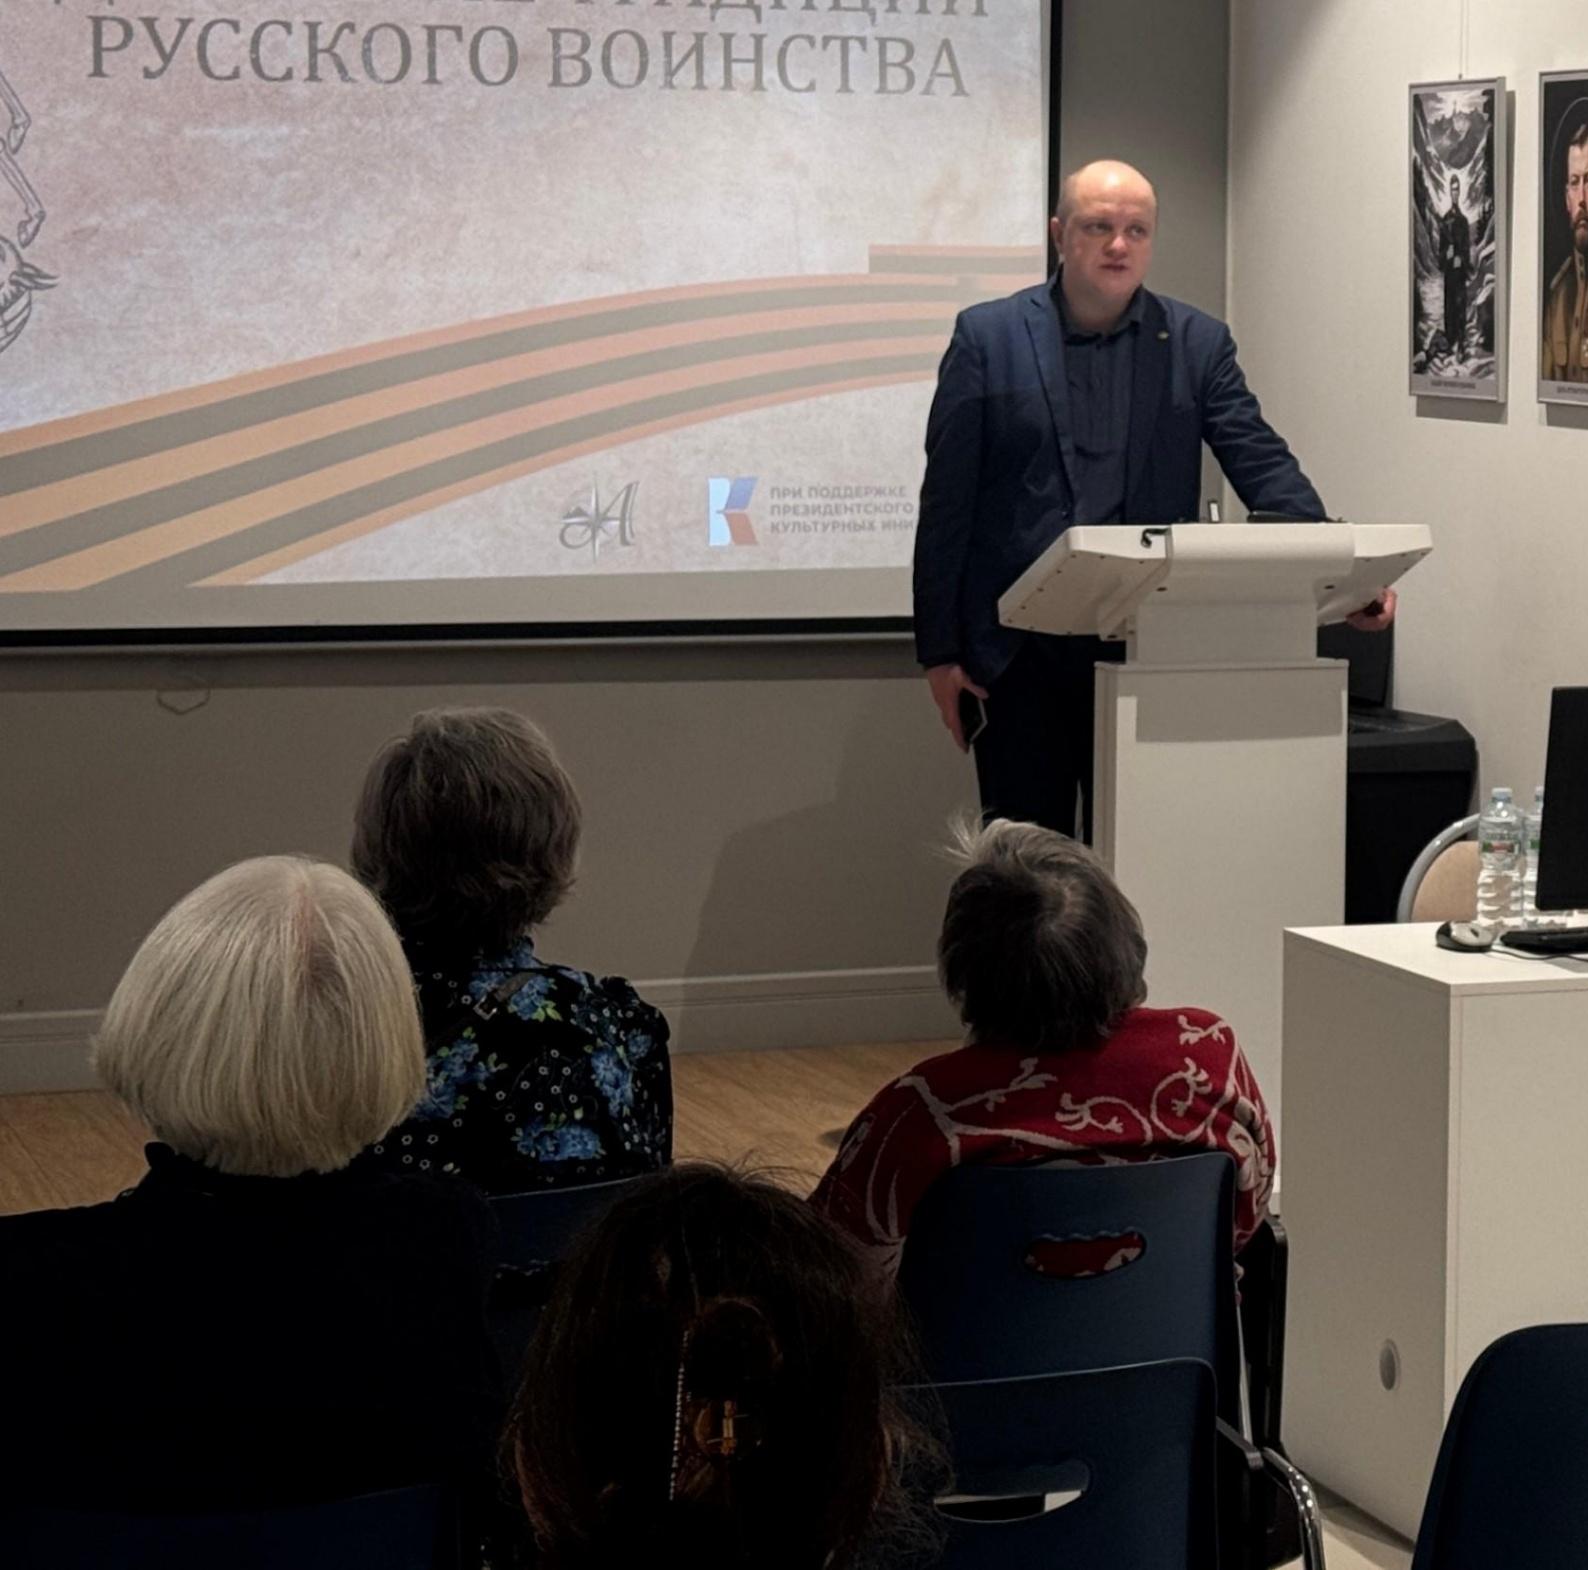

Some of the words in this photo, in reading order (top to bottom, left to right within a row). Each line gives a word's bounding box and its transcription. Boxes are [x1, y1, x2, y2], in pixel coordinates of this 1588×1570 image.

[86, 15, 518, 87] РУССКОГО
[547, 27, 970, 97] ВОИНСТВА
[770, 486, 802, 499] ПРИ
[808, 486, 907, 499] ПОДДЕРЖКЕ
[770, 502, 914, 516] ПРЕЗИДЕНТСКОГО
[770, 519, 875, 534] КУЛЬТУРНЫХ
[881, 518, 915, 532] ИНИ
